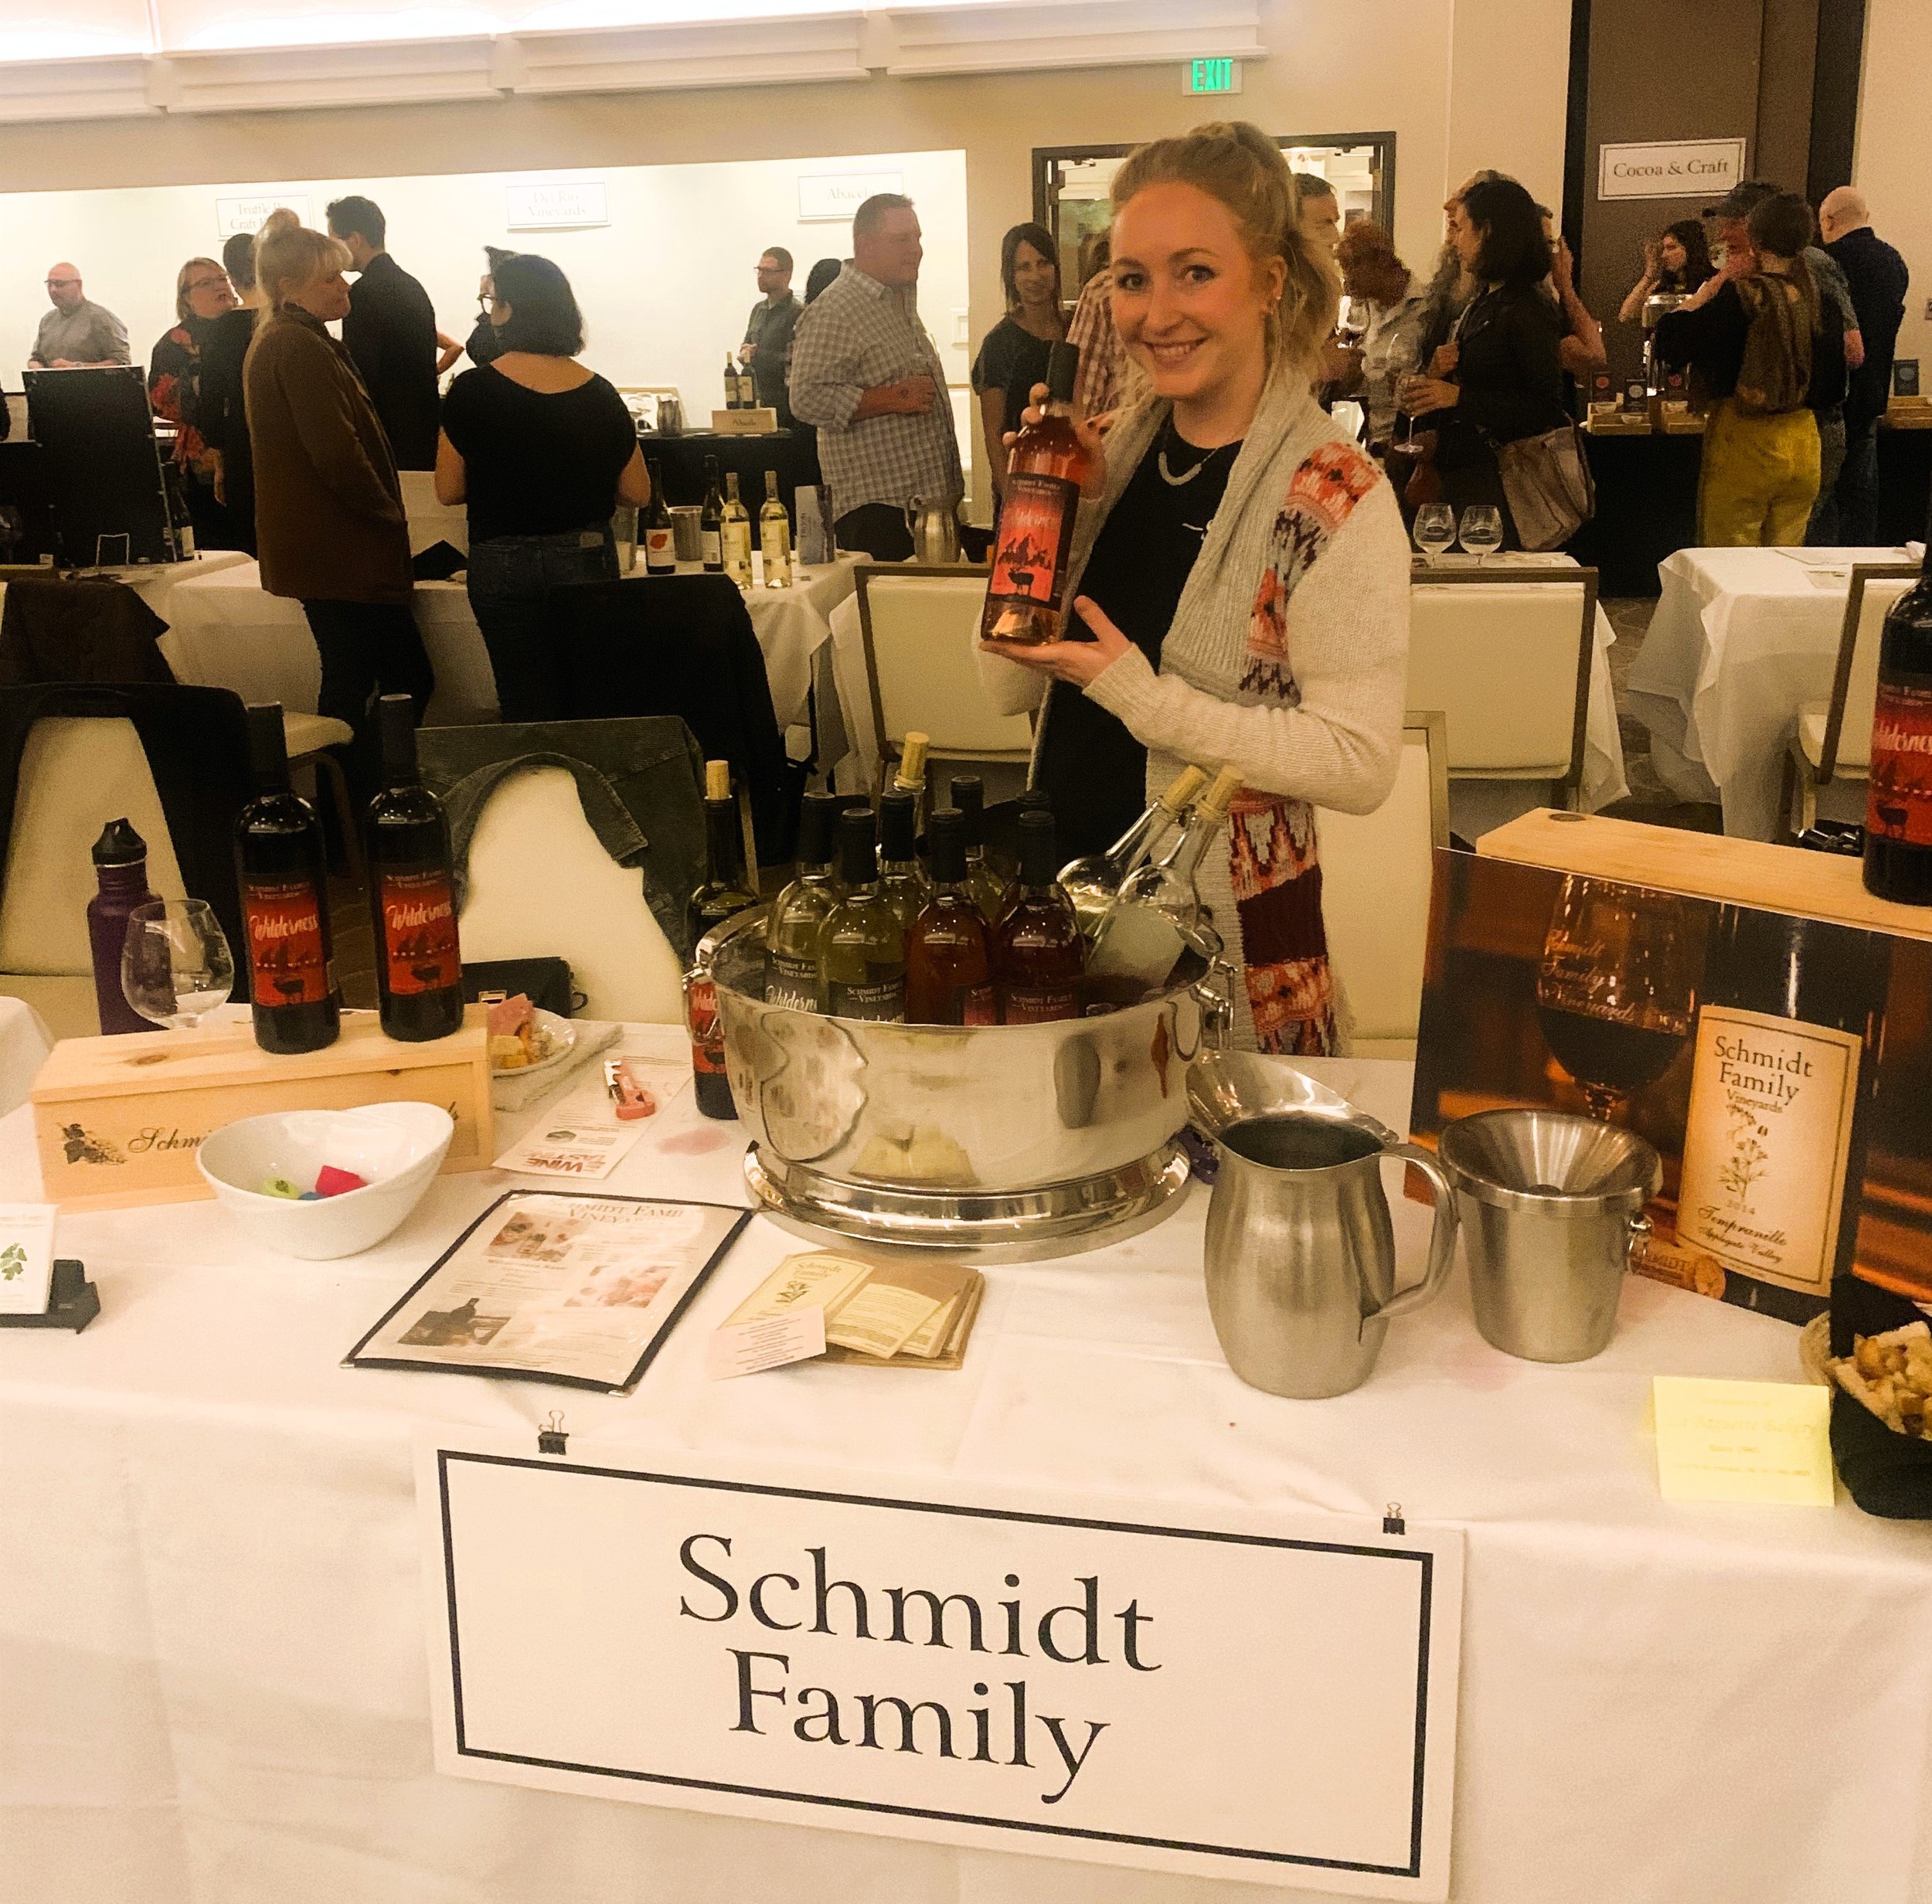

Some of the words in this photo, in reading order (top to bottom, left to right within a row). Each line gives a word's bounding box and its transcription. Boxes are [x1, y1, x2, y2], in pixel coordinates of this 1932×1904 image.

[1192, 59, 1233, 91] EXIT
[1614, 162, 1663, 178] Cocoa
[1667, 161, 1682, 175] &
[1687, 158, 1730, 175] Craft
[534, 191, 554, 203] Del
[527, 204, 587, 219] Vineyards
[249, 913, 319, 941] Wilderness
[1714, 1035, 1814, 1077] Schmidt
[1719, 1061, 1800, 1106] Family
[1726, 1088, 1784, 1114] Vineyards
[128, 1127, 212, 1153] Schmi
[522, 1158, 583, 1172] WINE
[679, 1534, 1162, 1671] Schmidt
[726, 1648, 1111, 1804] Family
